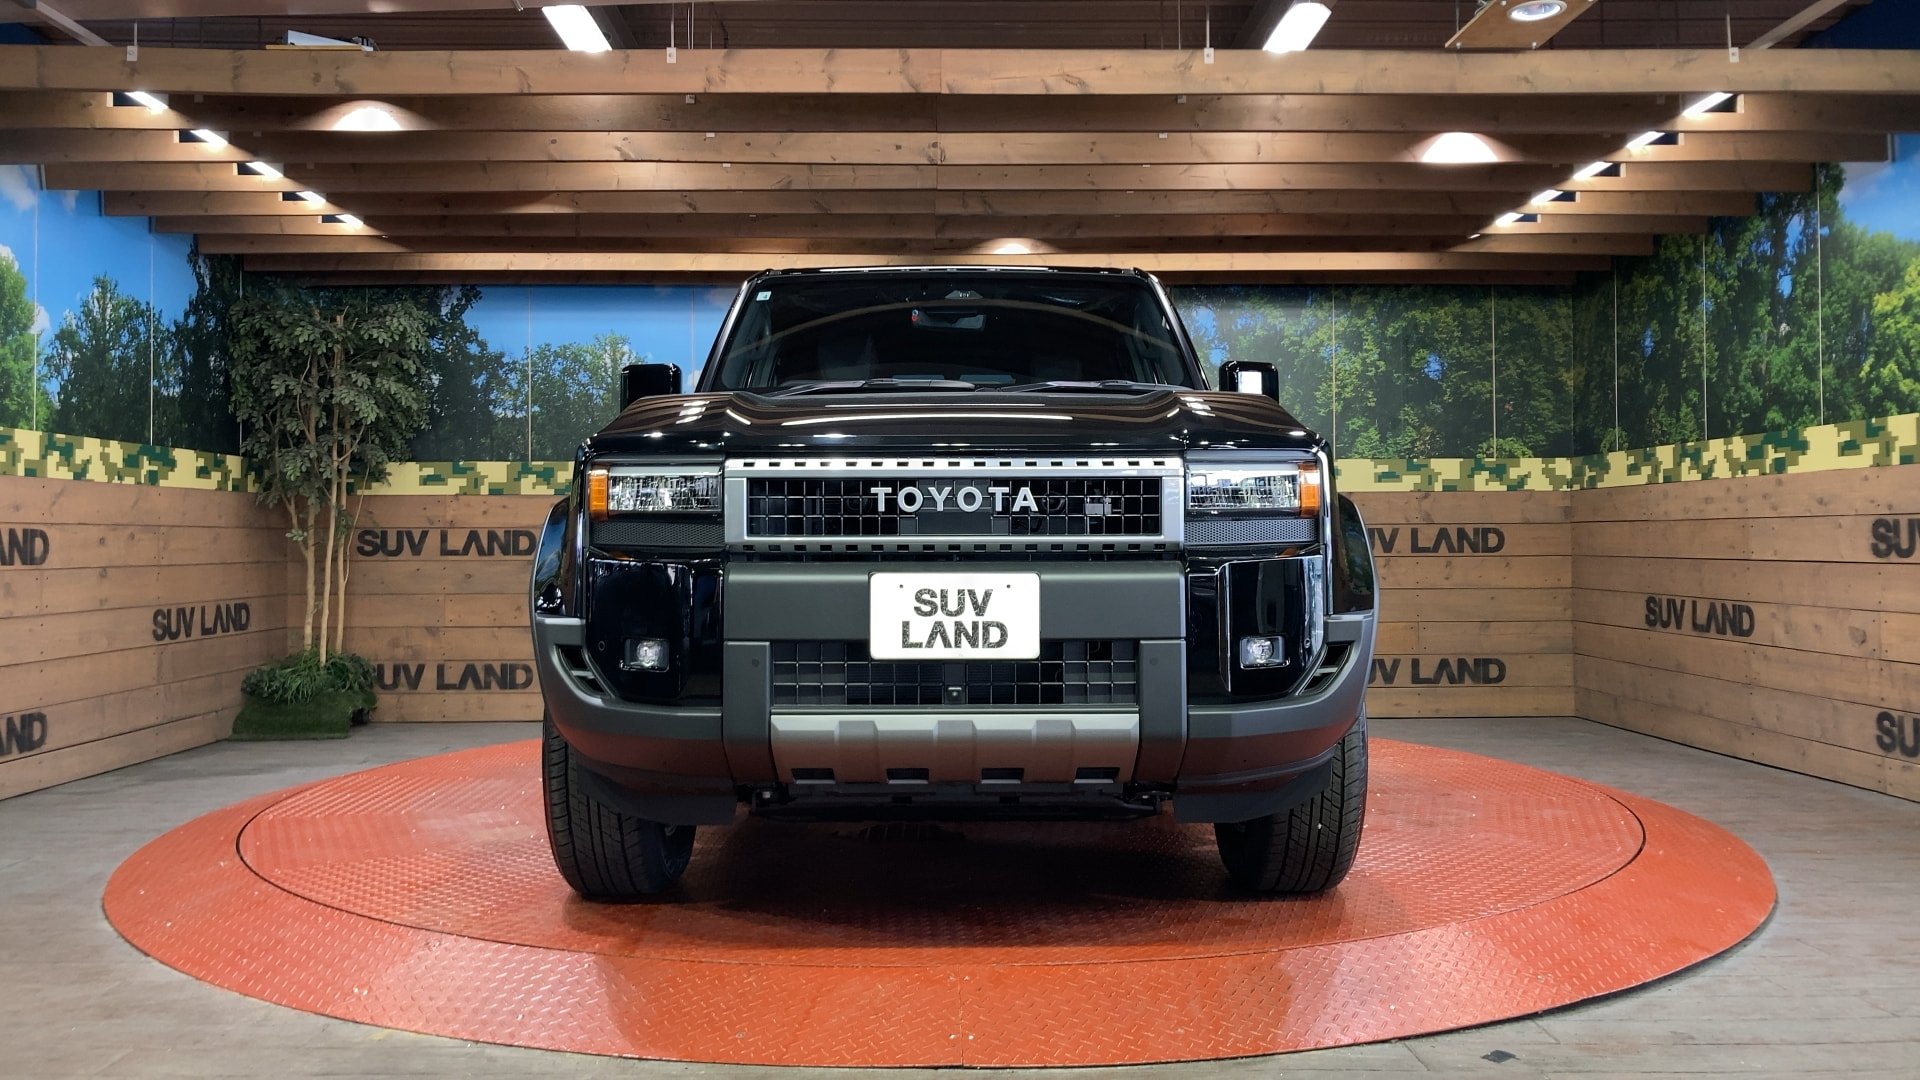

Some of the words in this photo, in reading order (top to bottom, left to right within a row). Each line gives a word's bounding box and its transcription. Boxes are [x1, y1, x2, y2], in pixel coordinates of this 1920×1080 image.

[871, 486, 1038, 512] TOYOTA
[357, 530, 429, 557] SUV
[440, 530, 537, 556] LAND
[1411, 527, 1506, 553] LAND
[1871, 518, 1920, 558] SU
[913, 588, 993, 617] SUV
[1645, 596, 1685, 630] SUV
[1692, 600, 1755, 637] LAND
[152, 606, 195, 641] SUV
[201, 602, 250, 636] LAND
[901, 620, 1009, 649] LAND
[376, 663, 426, 691] UV
[436, 663, 533, 690] LAND
[1411, 658, 1506, 684] LAND
